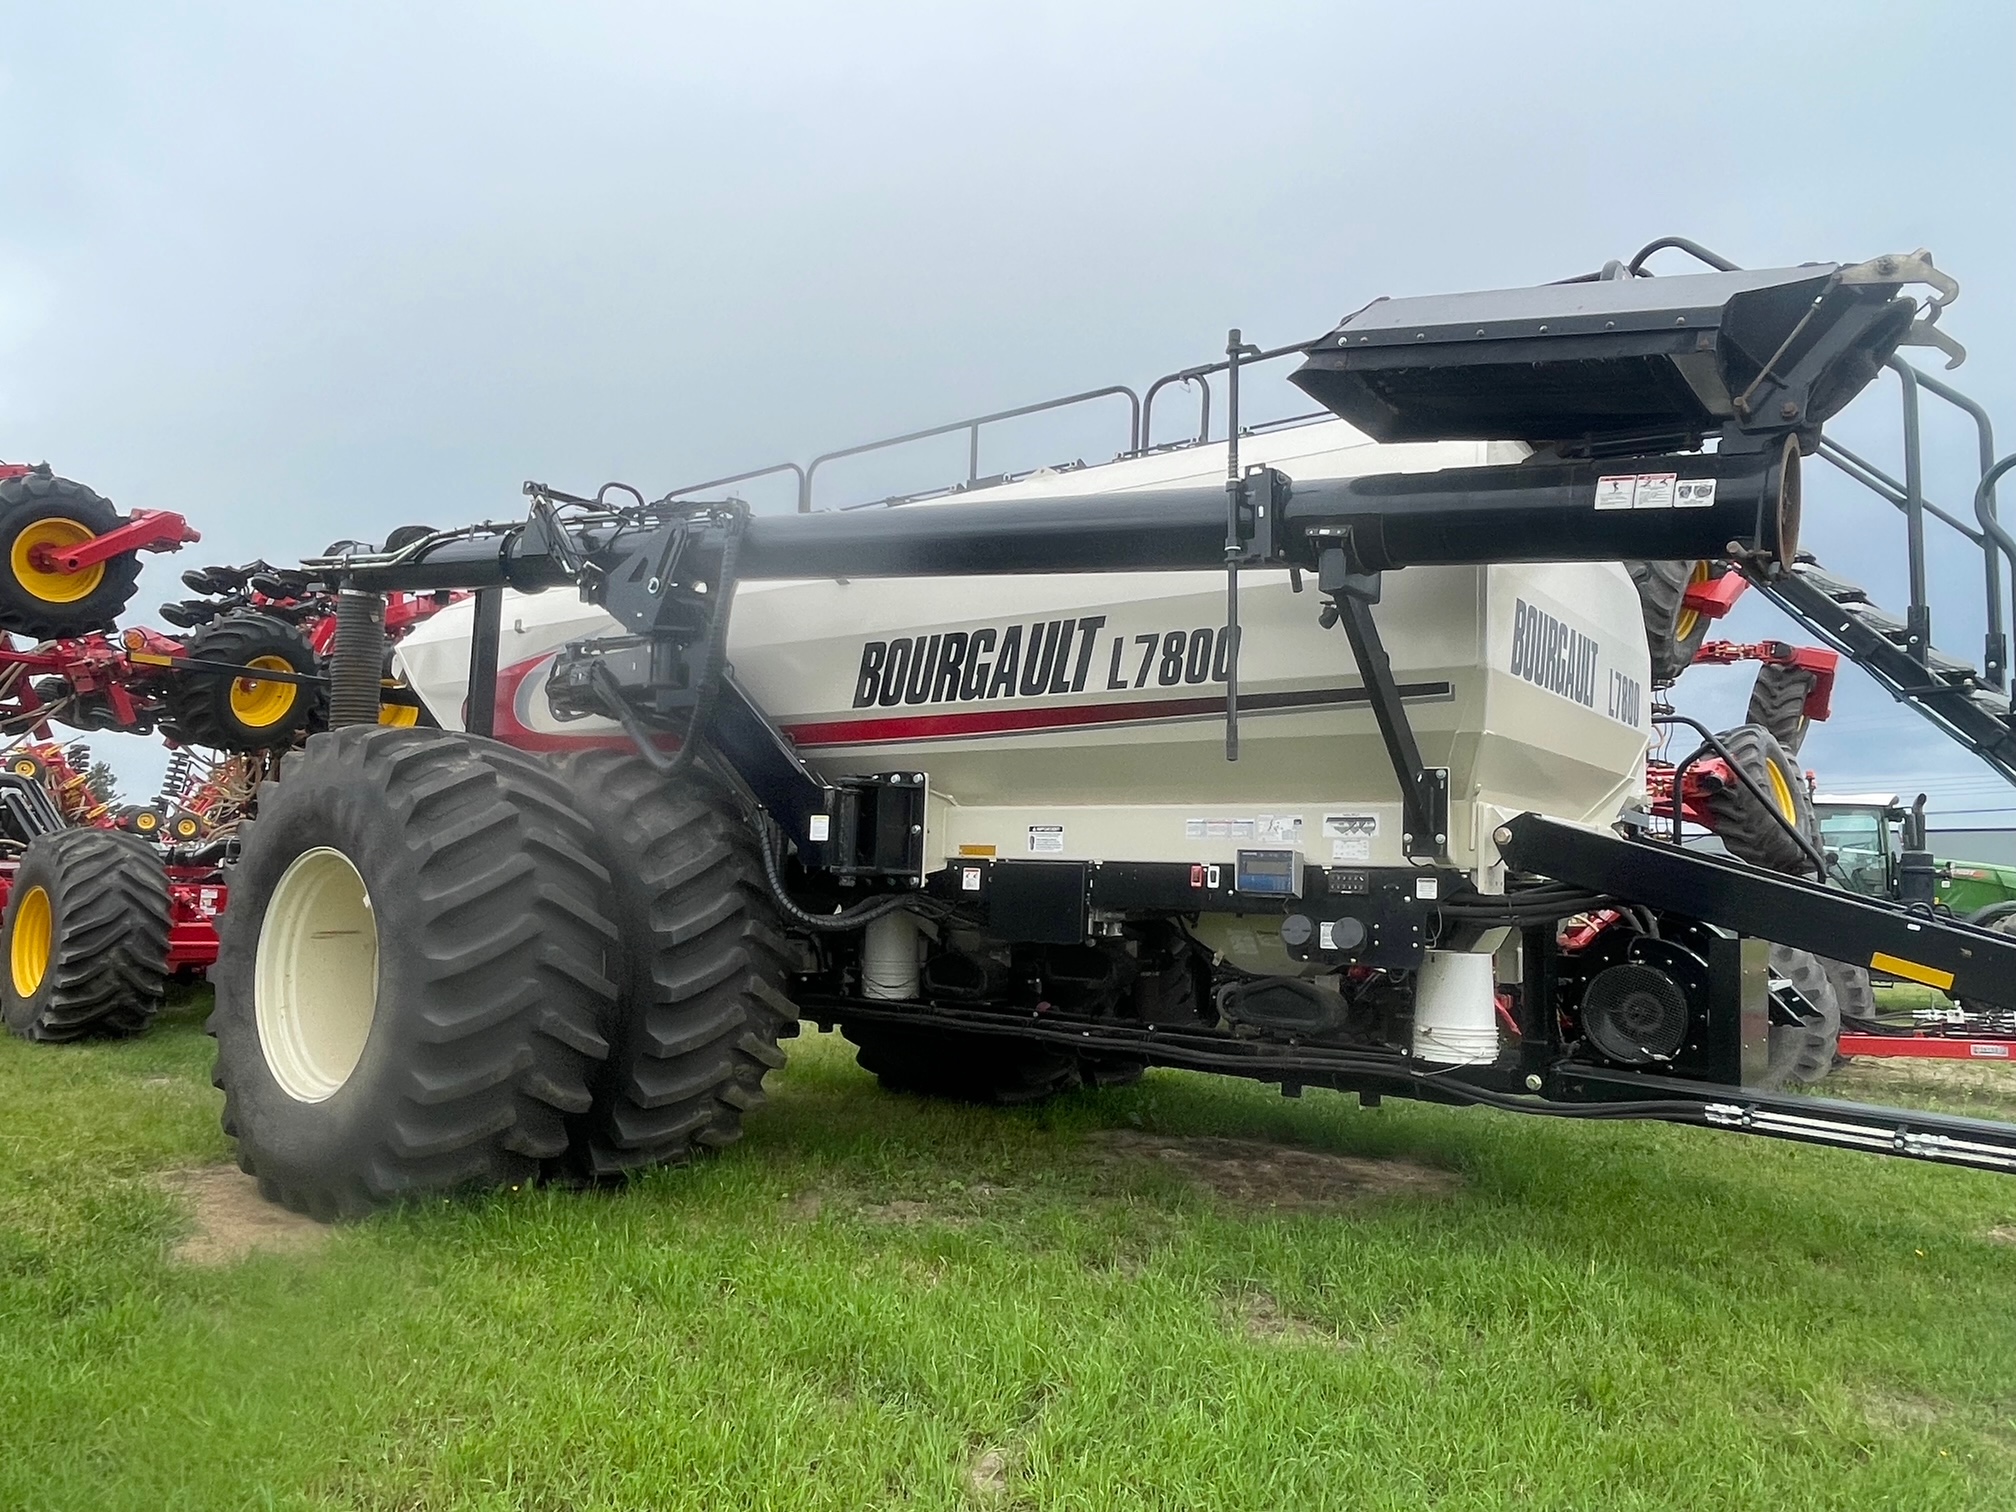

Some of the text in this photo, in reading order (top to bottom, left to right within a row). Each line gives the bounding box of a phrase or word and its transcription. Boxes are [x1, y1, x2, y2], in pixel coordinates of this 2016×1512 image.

[853, 615, 1106, 708] BOURGAULT
[1511, 597, 1640, 728] BOURGAULT L7800
